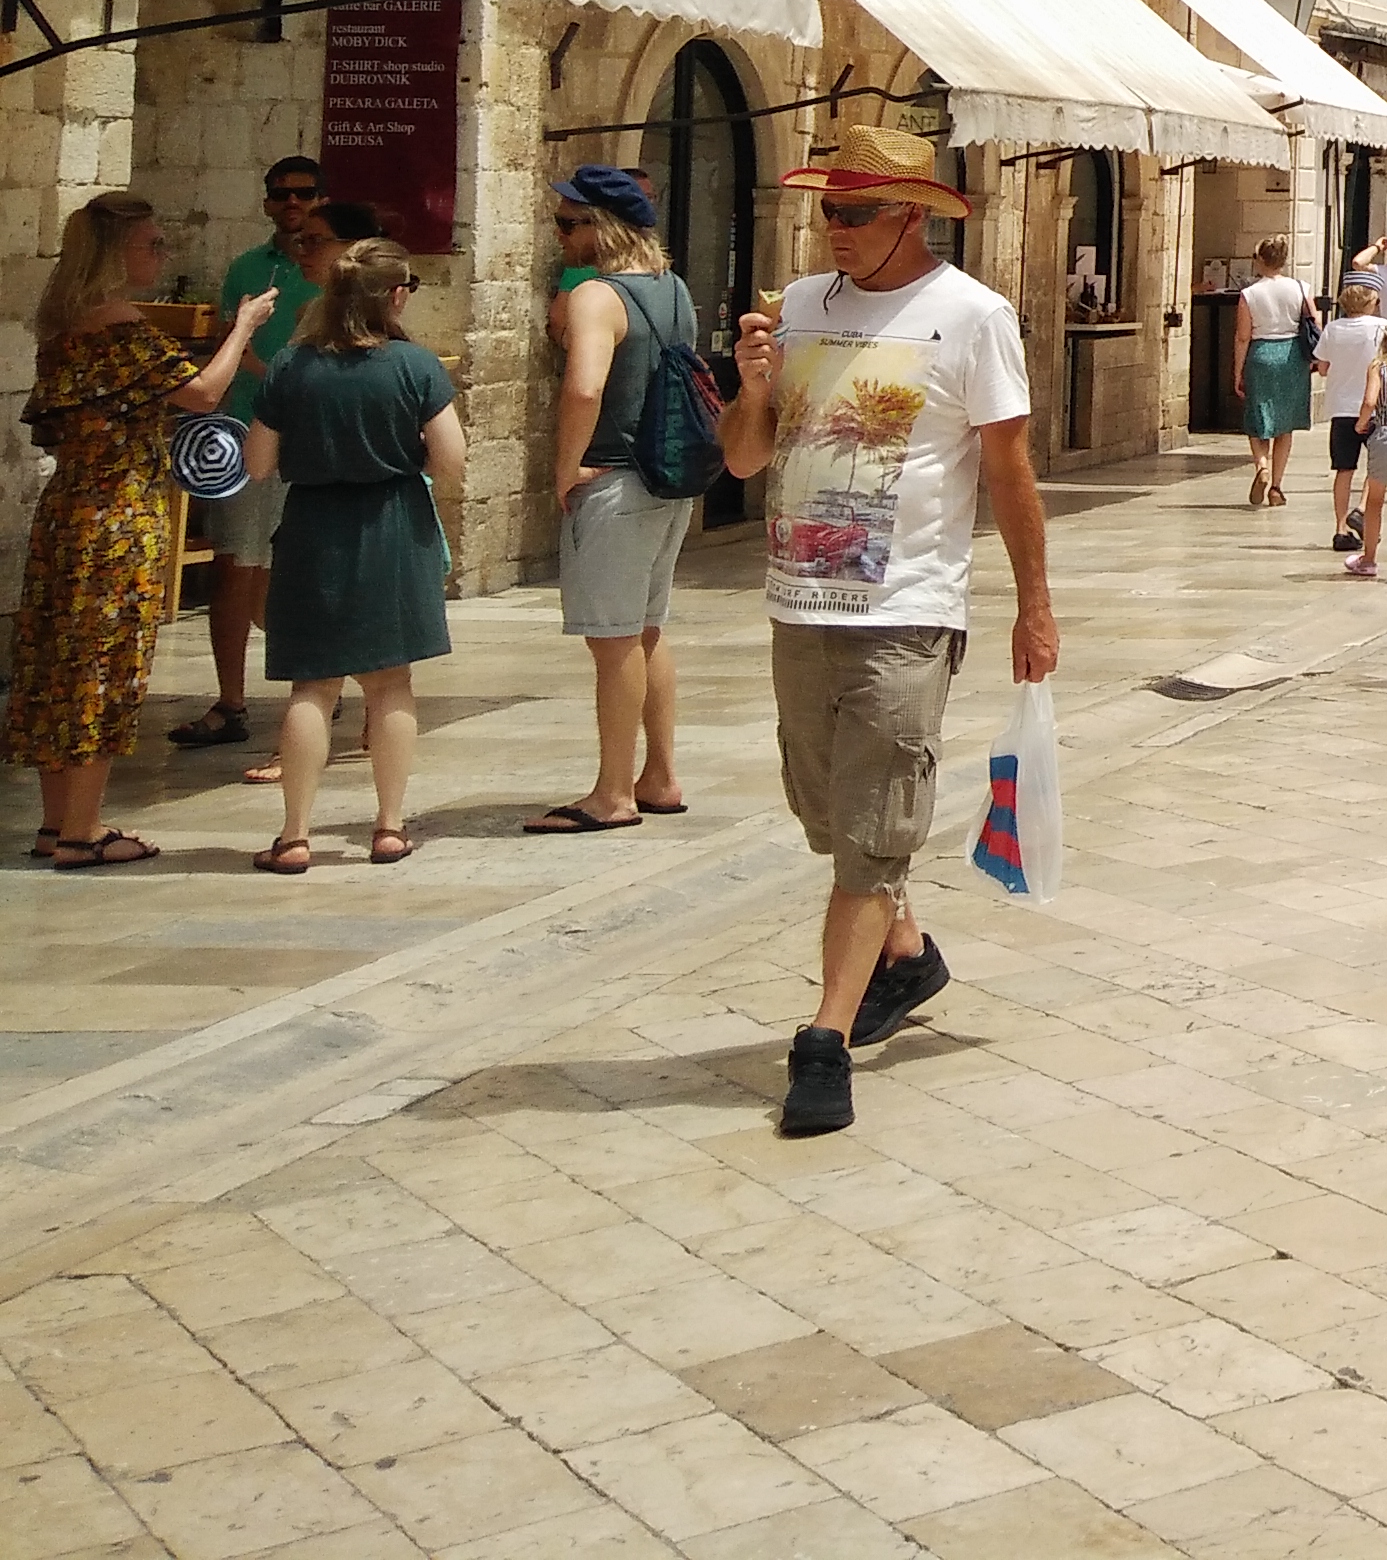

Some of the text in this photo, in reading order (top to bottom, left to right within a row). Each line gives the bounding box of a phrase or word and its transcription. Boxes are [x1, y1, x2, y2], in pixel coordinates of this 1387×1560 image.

[383, 0, 442, 12] GALERIE
[331, 24, 386, 34] restaurant
[331, 36, 408, 47] MOBY DICK
[331, 60, 446, 74] T-SHIRT shop studio
[330, 73, 411, 85] DUBROVNIK
[328, 97, 439, 109] PEKARA GALETA
[327, 121, 415, 135] Gift & Art Shop
[327, 134, 384, 146] MEDUSA
[841, 329, 863, 338] CUBA
[819, 338, 879, 349] SUMMER VIBES
[811, 591, 868, 602] RIDERS
